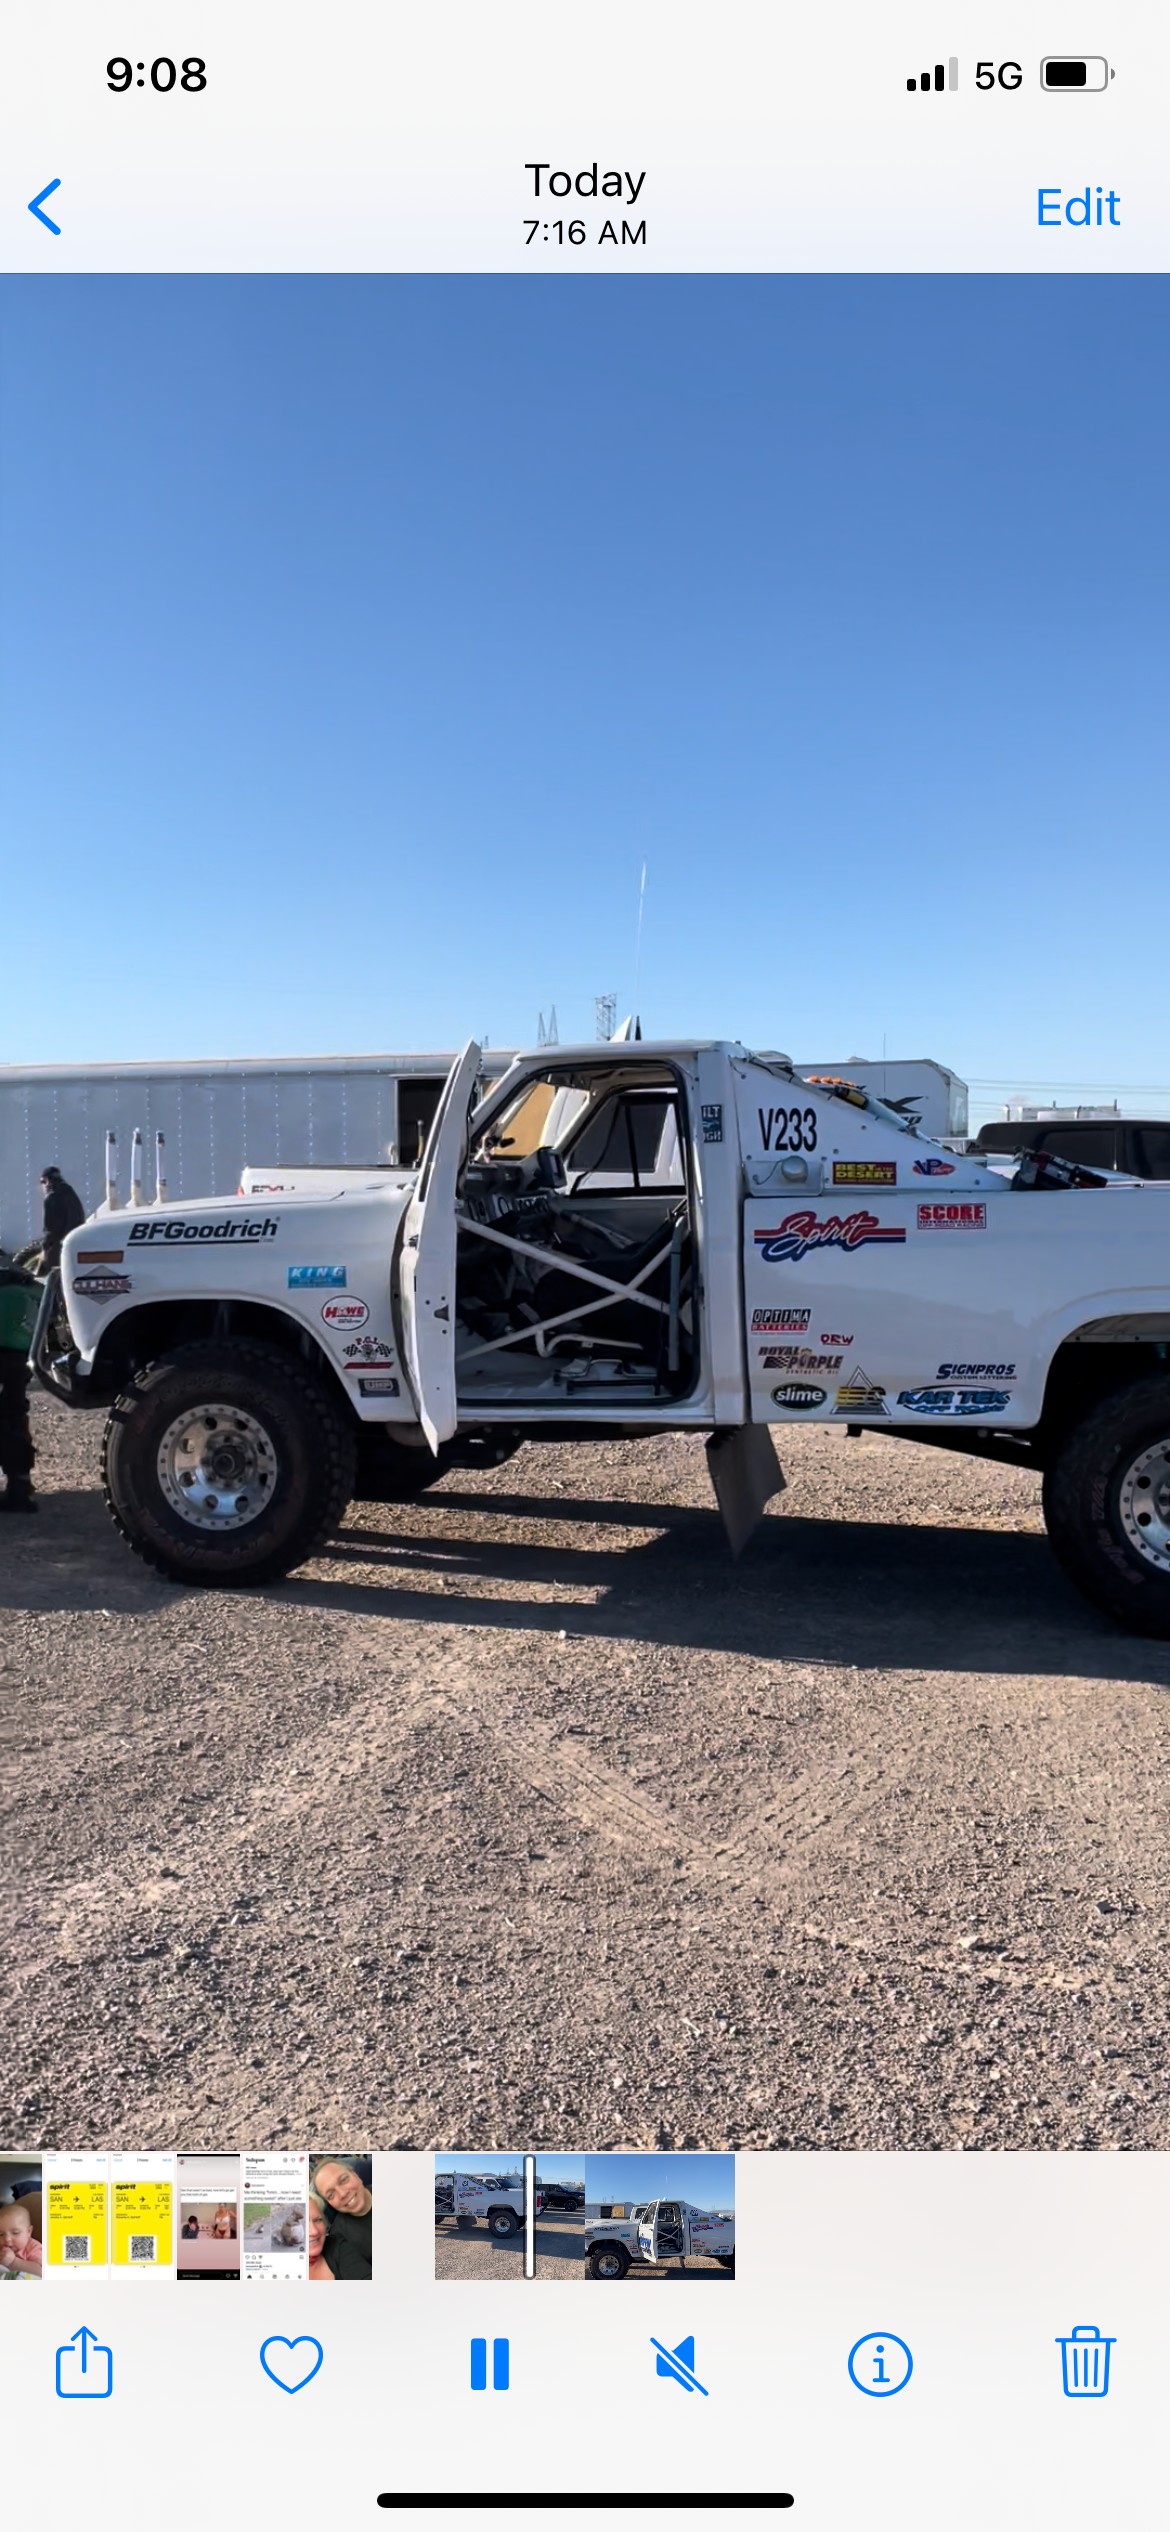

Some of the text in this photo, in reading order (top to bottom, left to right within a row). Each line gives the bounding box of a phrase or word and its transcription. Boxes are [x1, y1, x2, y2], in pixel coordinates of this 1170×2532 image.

[106, 56, 207, 93] 9:08
[975, 61, 1023, 91] 5G
[524, 162, 647, 205] Today
[1036, 186, 1121, 227] Edit
[522, 219, 647, 246] 7:16 AM
[758, 1107, 818, 1152] V233
[914, 1158, 943, 1175] VP
[919, 1205, 984, 1219] SCORE
[128, 1218, 278, 1240] BFGoodrich
[768, 1215, 873, 1256] Spirit
[291, 1266, 344, 1277] KING
[325, 1306, 365, 1318] HOWE
[753, 1309, 809, 1322] OPTIMA
[758, 1346, 800, 1355] ROYAL
[787, 1355, 844, 1369] PURPLE
[936, 1364, 1016, 1380] SIGNPROS
[776, 1387, 823, 1401] slime
[896, 1391, 1012, 1404] KAR TEK
